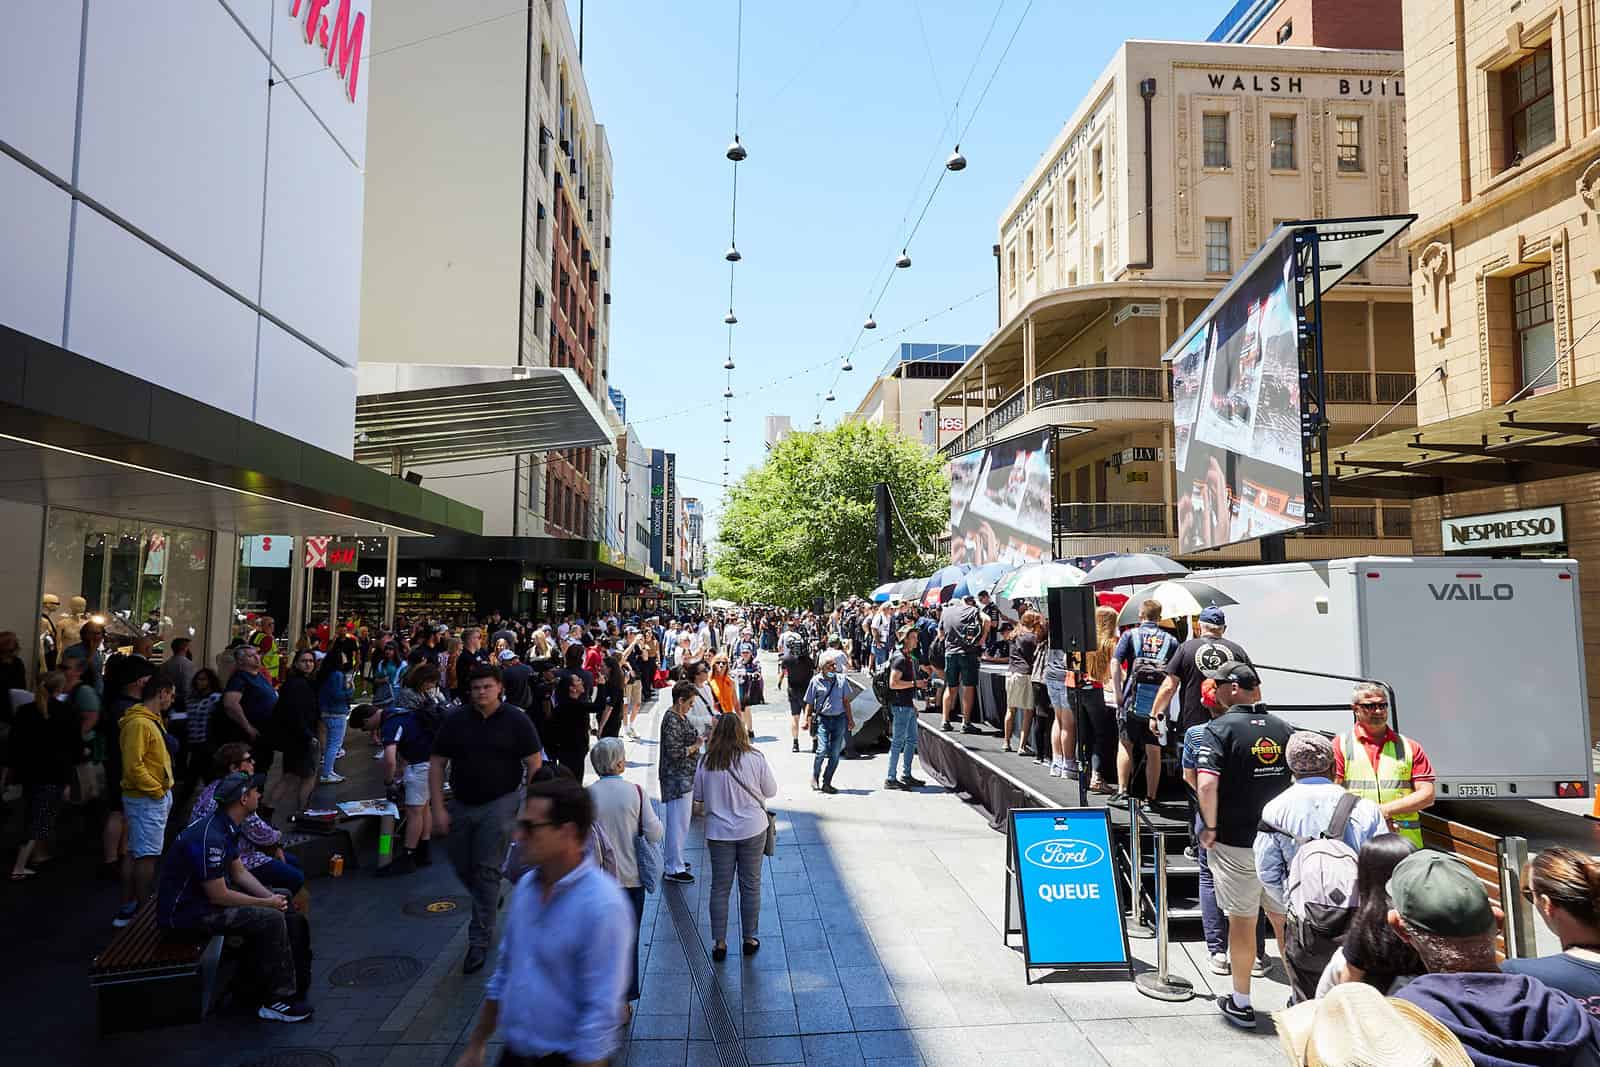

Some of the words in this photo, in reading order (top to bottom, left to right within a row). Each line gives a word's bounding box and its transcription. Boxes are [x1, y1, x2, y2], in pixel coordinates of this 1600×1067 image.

[1207, 74, 1303, 93] WALSH
[1450, 517, 1555, 545] NESPRESSO
[374, 576, 418, 588] HPE
[558, 572, 591, 581] HYPE
[1428, 583, 1514, 601] VAILO
[1041, 842, 1088, 864] Ford
[1038, 884, 1100, 902] QUEUE
